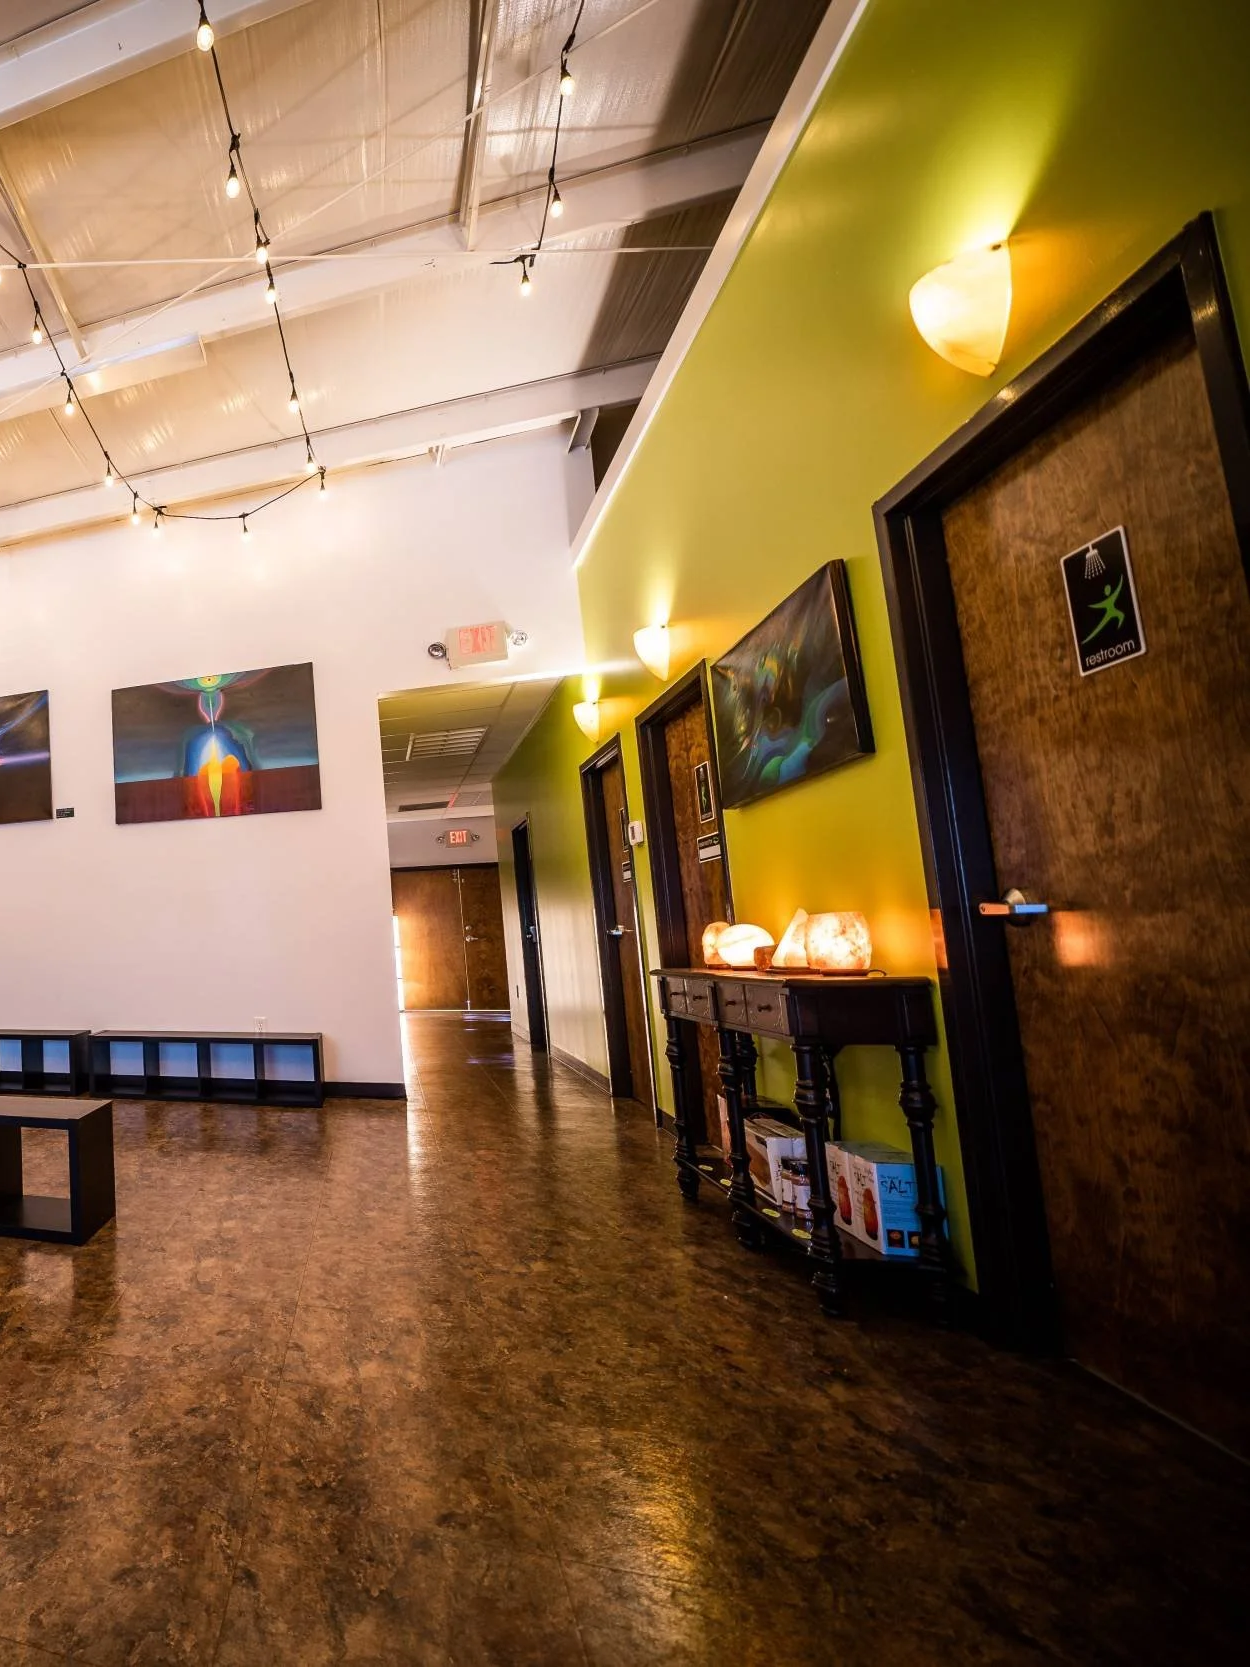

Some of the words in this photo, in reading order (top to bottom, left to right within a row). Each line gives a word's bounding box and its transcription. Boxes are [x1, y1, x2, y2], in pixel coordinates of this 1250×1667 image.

[458, 625, 497, 656] EXIT
[1085, 639, 1135, 667] restroom
[450, 830, 467, 844] EXIT
[880, 1179, 916, 1194] SALT
